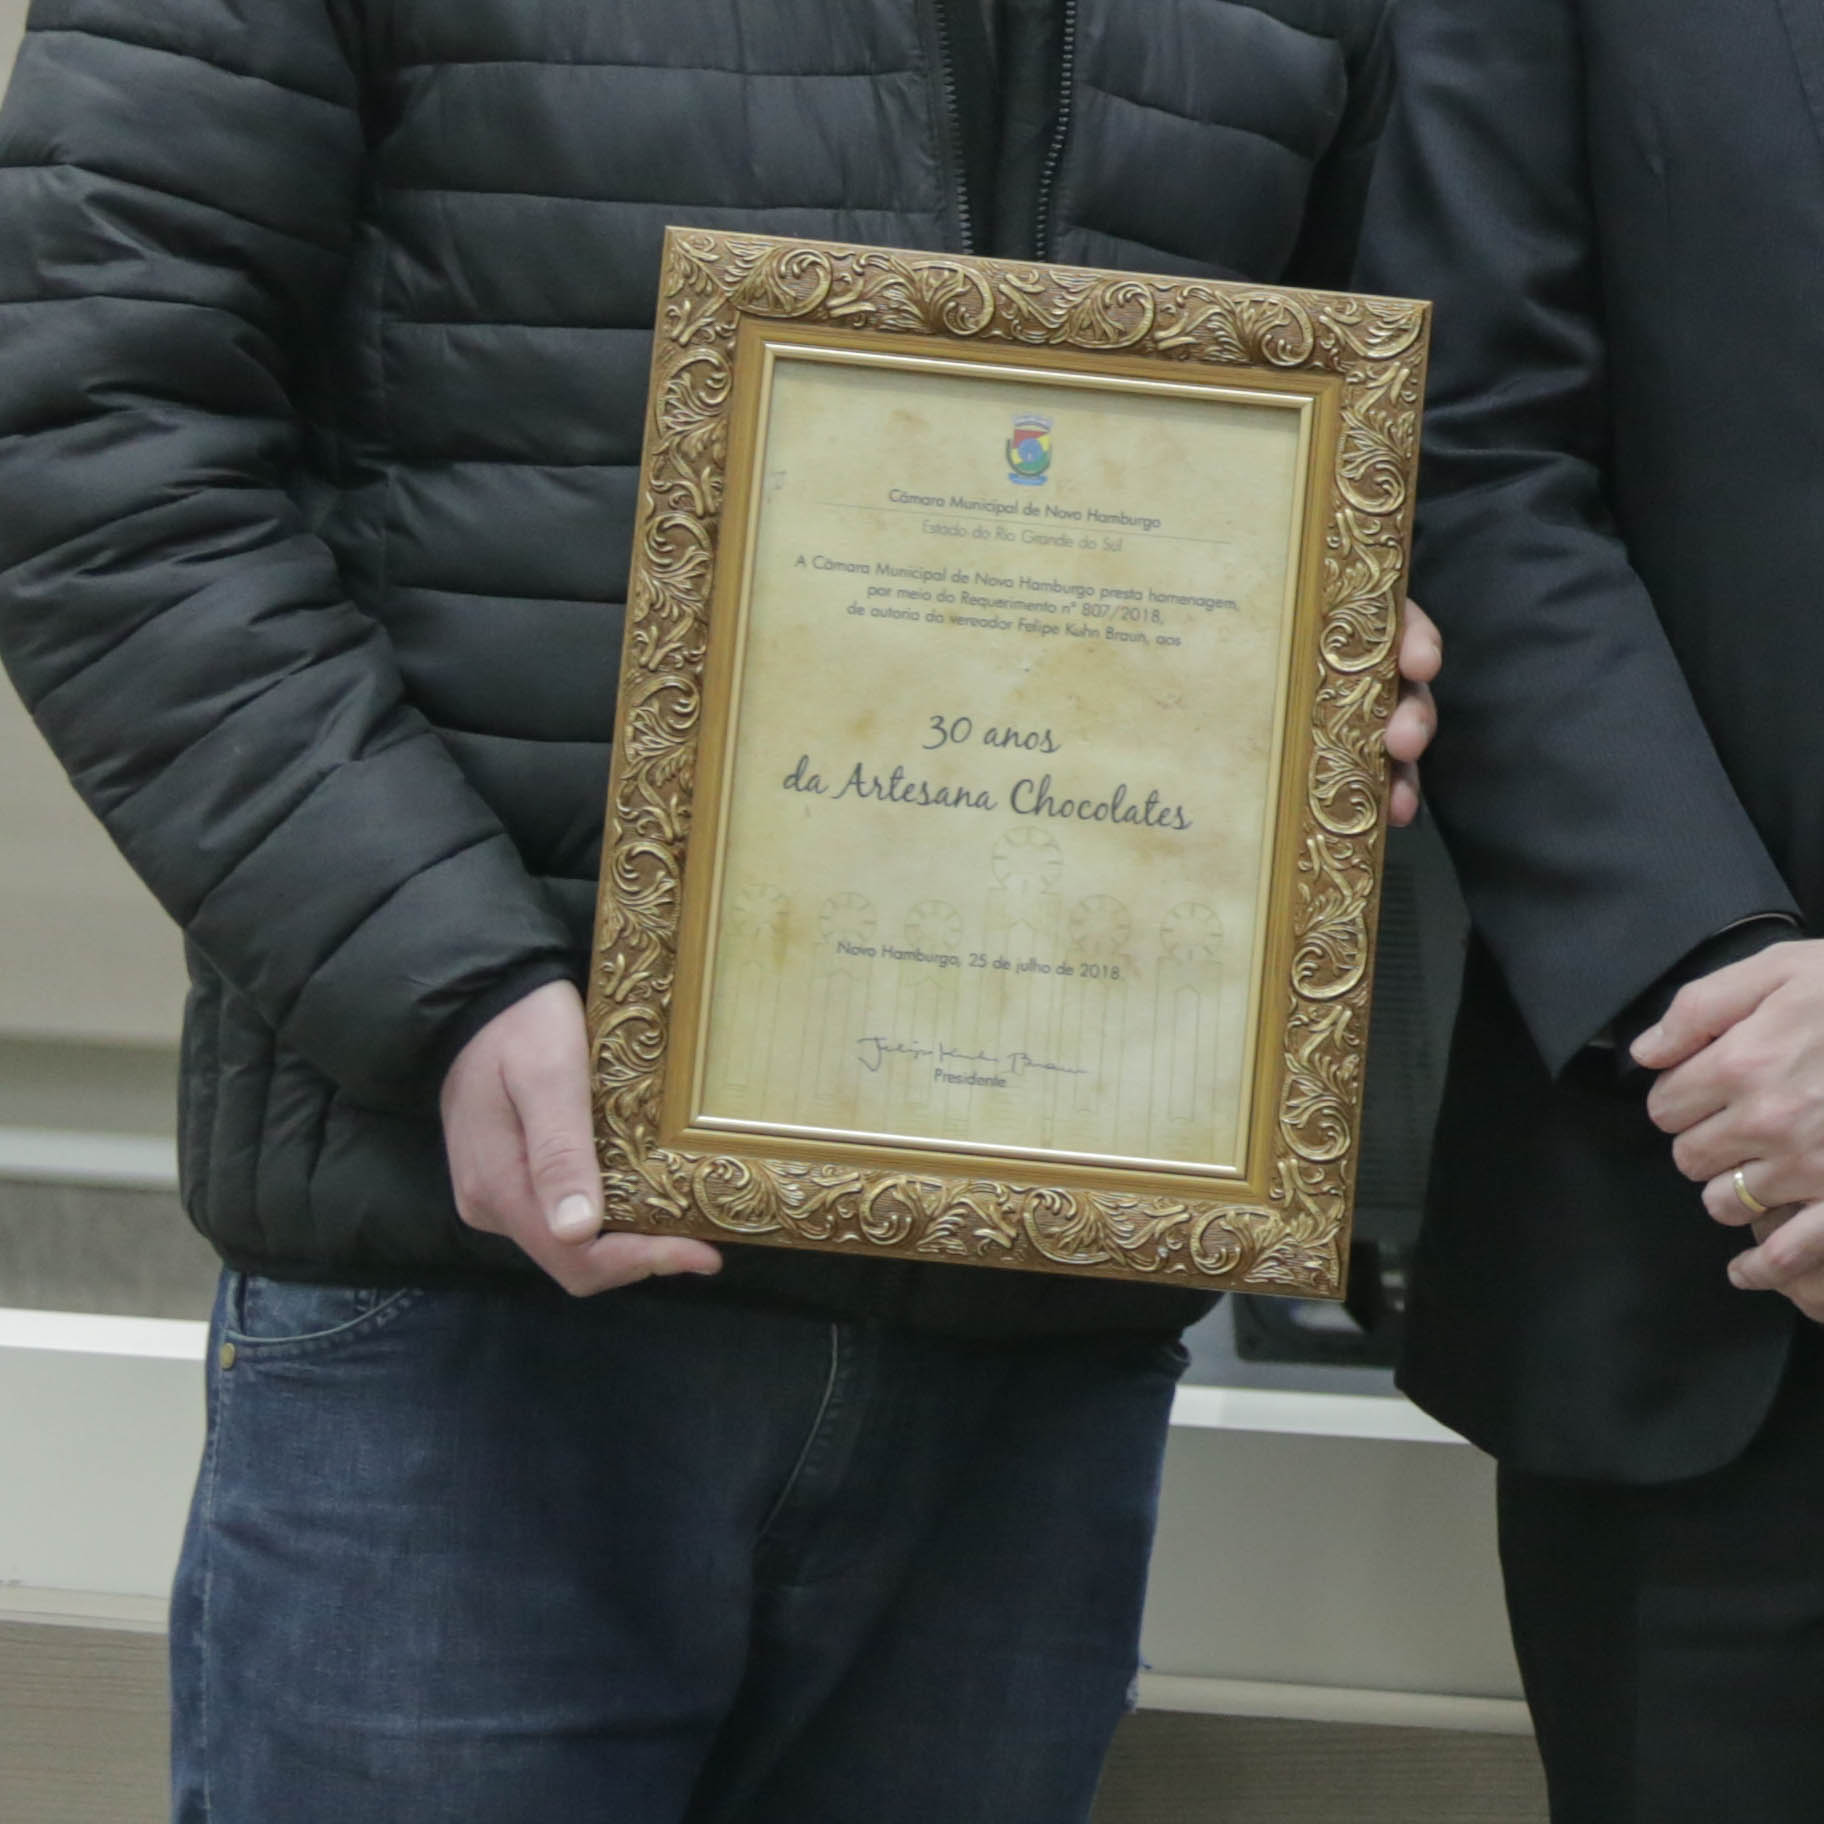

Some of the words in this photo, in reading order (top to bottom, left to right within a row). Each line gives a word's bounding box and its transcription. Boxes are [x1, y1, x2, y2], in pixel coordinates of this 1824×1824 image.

[888, 489, 945, 508] Câmara
[950, 496, 1018, 515] Municipal
[1023, 502, 1040, 516] de
[1044, 506, 1082, 521] Novo
[1087, 510, 1161, 531] Hamburgo
[922, 520, 967, 537] Estado
[1021, 530, 1073, 548] Grande
[1102, 537, 1123, 552] Sul
[795, 555, 806, 567] A
[811, 555, 870, 574] Câmara
[875, 563, 946, 583] Municipal
[951, 569, 970, 584] de
[975, 572, 1014, 588] Novo
[1019, 576, 1095, 599] Hamburgo
[1100, 587, 1142, 602] presta
[867, 585, 891, 599] por
[896, 587, 932, 601] meio
[960, 591, 1057, 613] Requerimento
[847, 601, 865, 616] de
[870, 606, 920, 621] autoria
[949, 612, 1013, 630] vereador
[1018, 618, 1059, 636] Felipe
[1155, 634, 1182, 647] aos
[922, 714, 972, 750] 30
[983, 725, 1062, 754] anos
[782, 754, 828, 795] da
[832, 762, 998, 812] Artesana
[1009, 773, 1193, 831] Chocolates
[836, 941, 875, 958] Novo
[881, 944, 961, 968] Hamburgo,
[968, 953, 988, 968] 25
[992, 956, 1011, 971] de
[1016, 958, 1050, 975] julho
[1056, 960, 1074, 976] de
[934, 1068, 1007, 1088] Presidente
